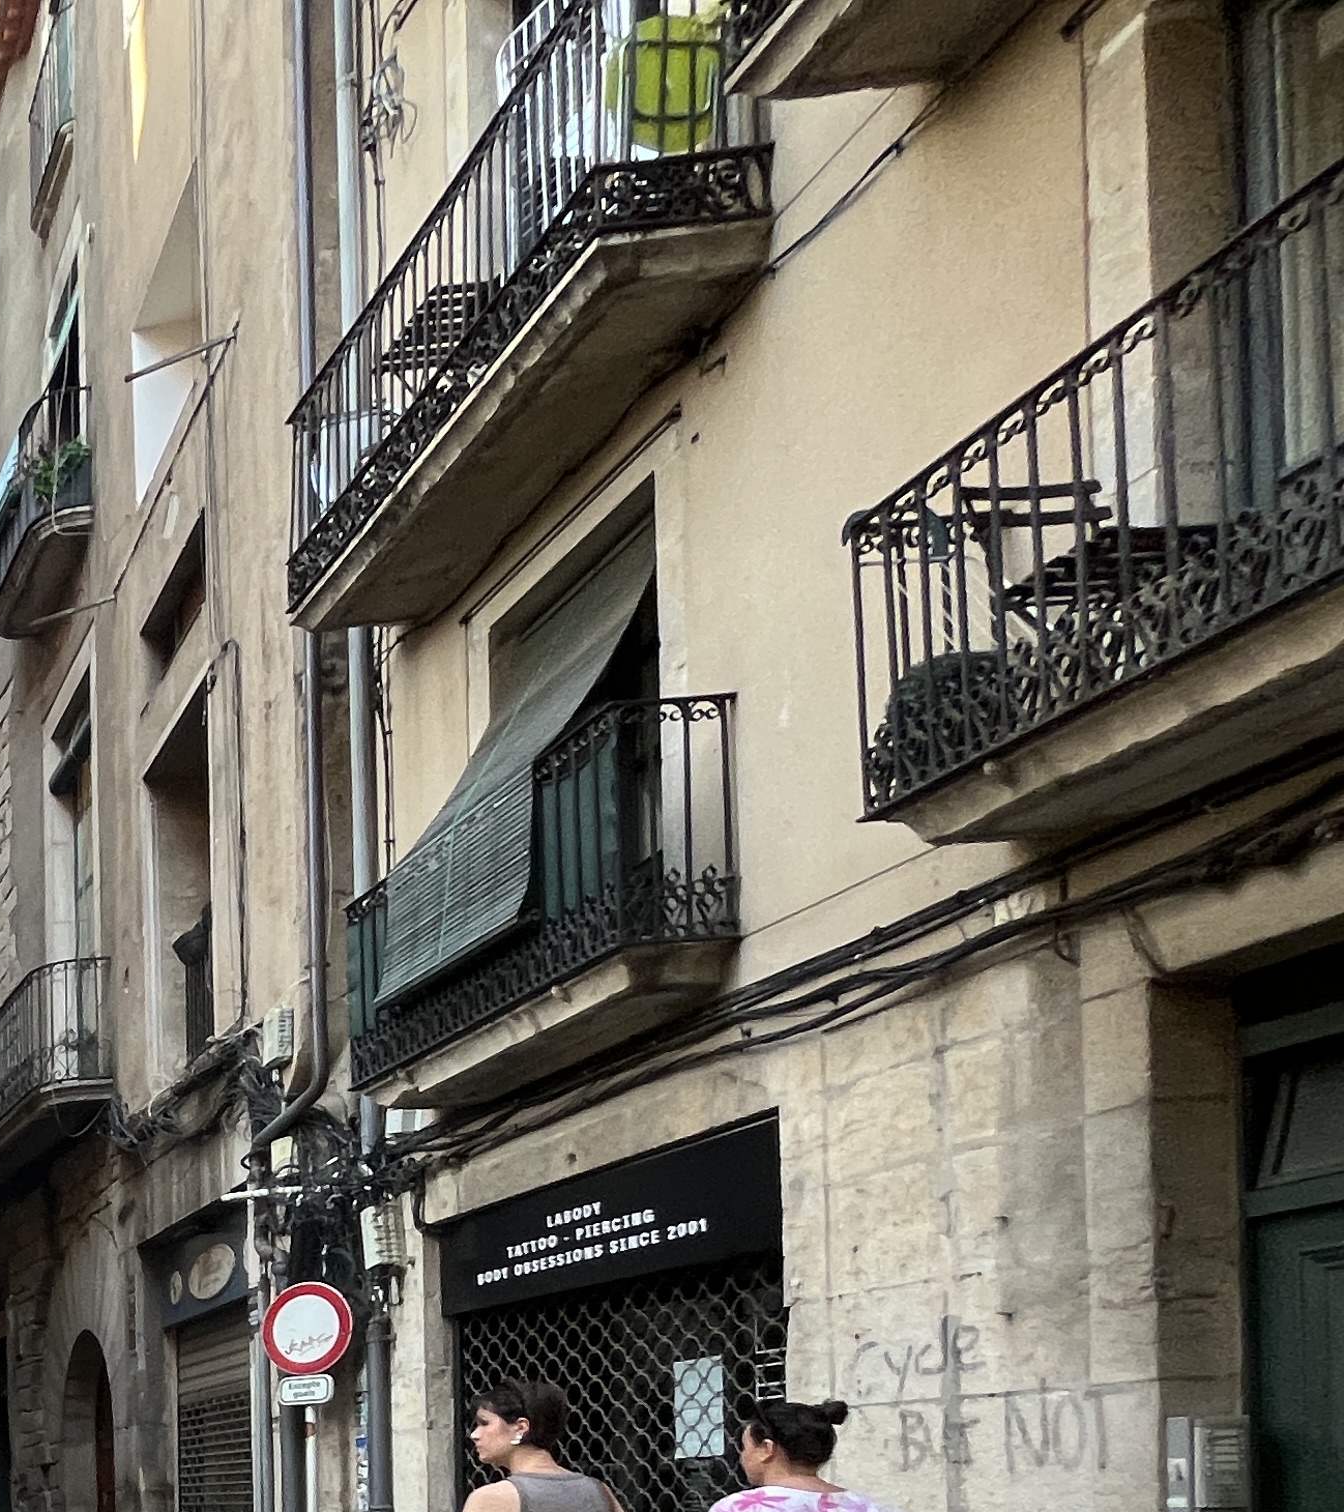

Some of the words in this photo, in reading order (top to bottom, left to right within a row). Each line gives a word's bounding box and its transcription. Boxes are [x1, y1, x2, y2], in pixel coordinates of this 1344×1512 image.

[506, 1234, 559, 1259] TATTOO
[574, 1208, 657, 1241] PIERCING
[545, 1201, 603, 1228] LABODY
[476, 1266, 510, 1286] BODY
[513, 1244, 605, 1277] OBSESSIONS
[609, 1229, 661, 1254] SINCE
[666, 1217, 709, 1241] 2001
